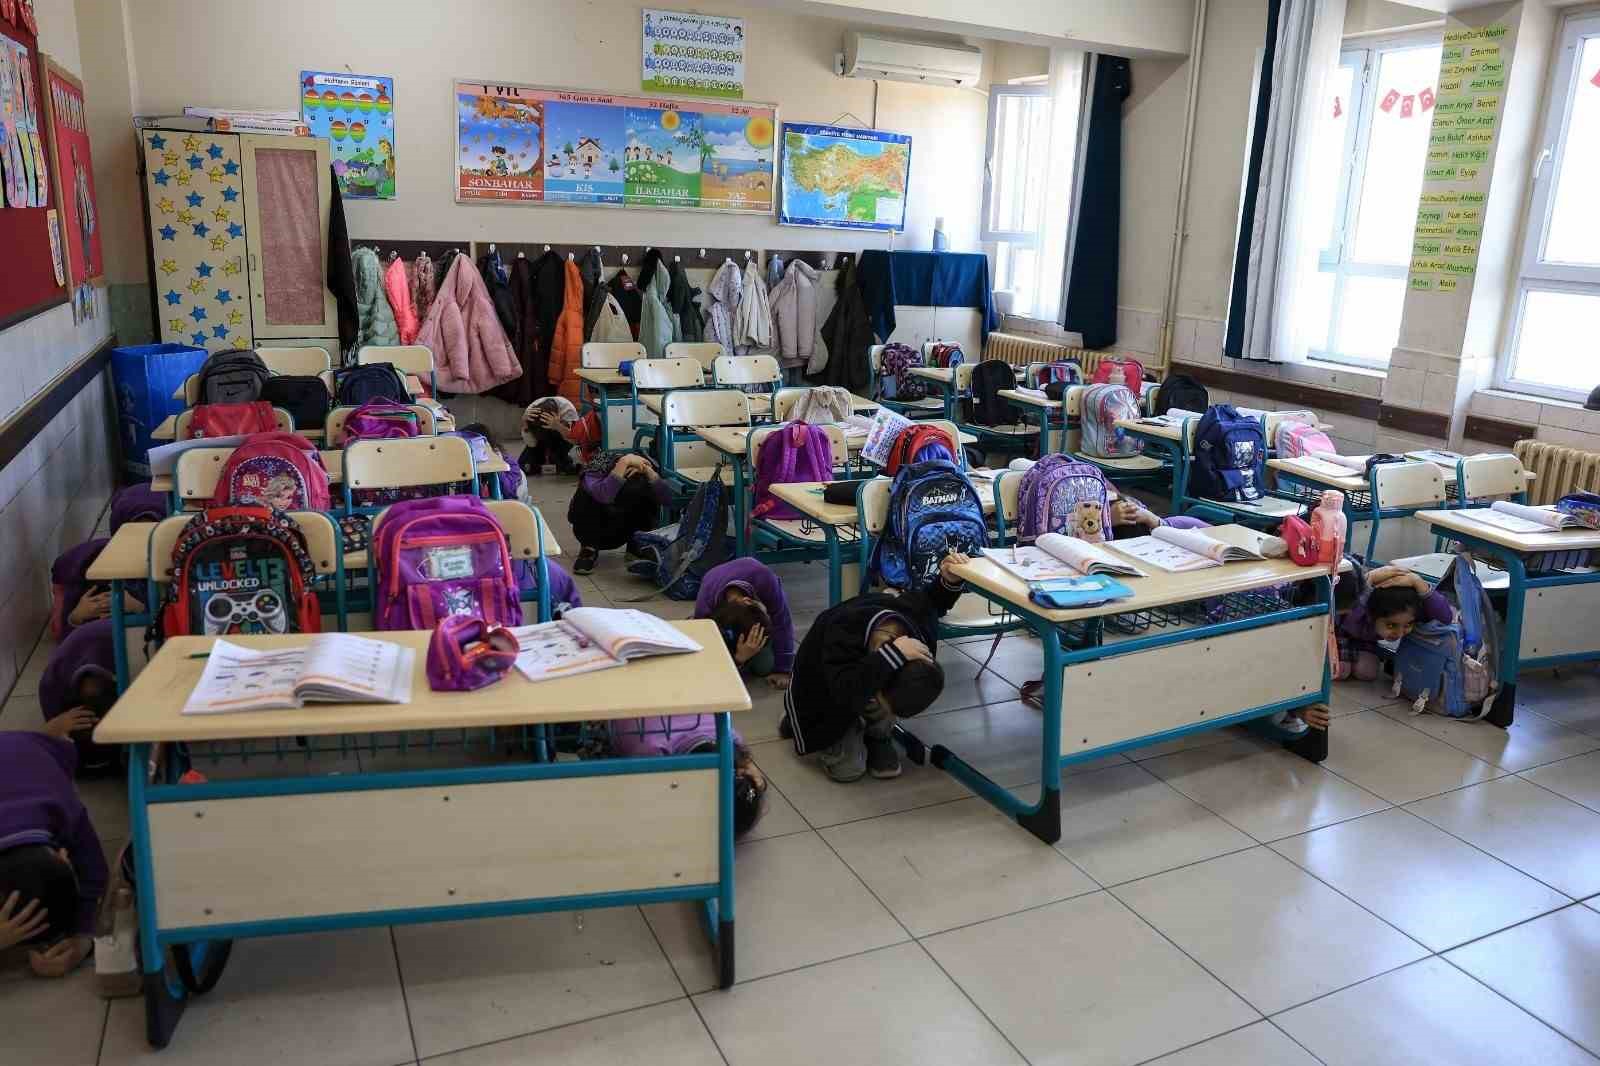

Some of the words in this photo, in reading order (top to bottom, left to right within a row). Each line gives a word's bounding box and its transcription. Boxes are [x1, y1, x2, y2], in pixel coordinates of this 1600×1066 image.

[468, 177, 533, 190] SONBAHAR
[922, 493, 957, 505] BATMAN
[196, 560, 257, 579] LEVEL
[197, 578, 260, 591] UNLOCKED
